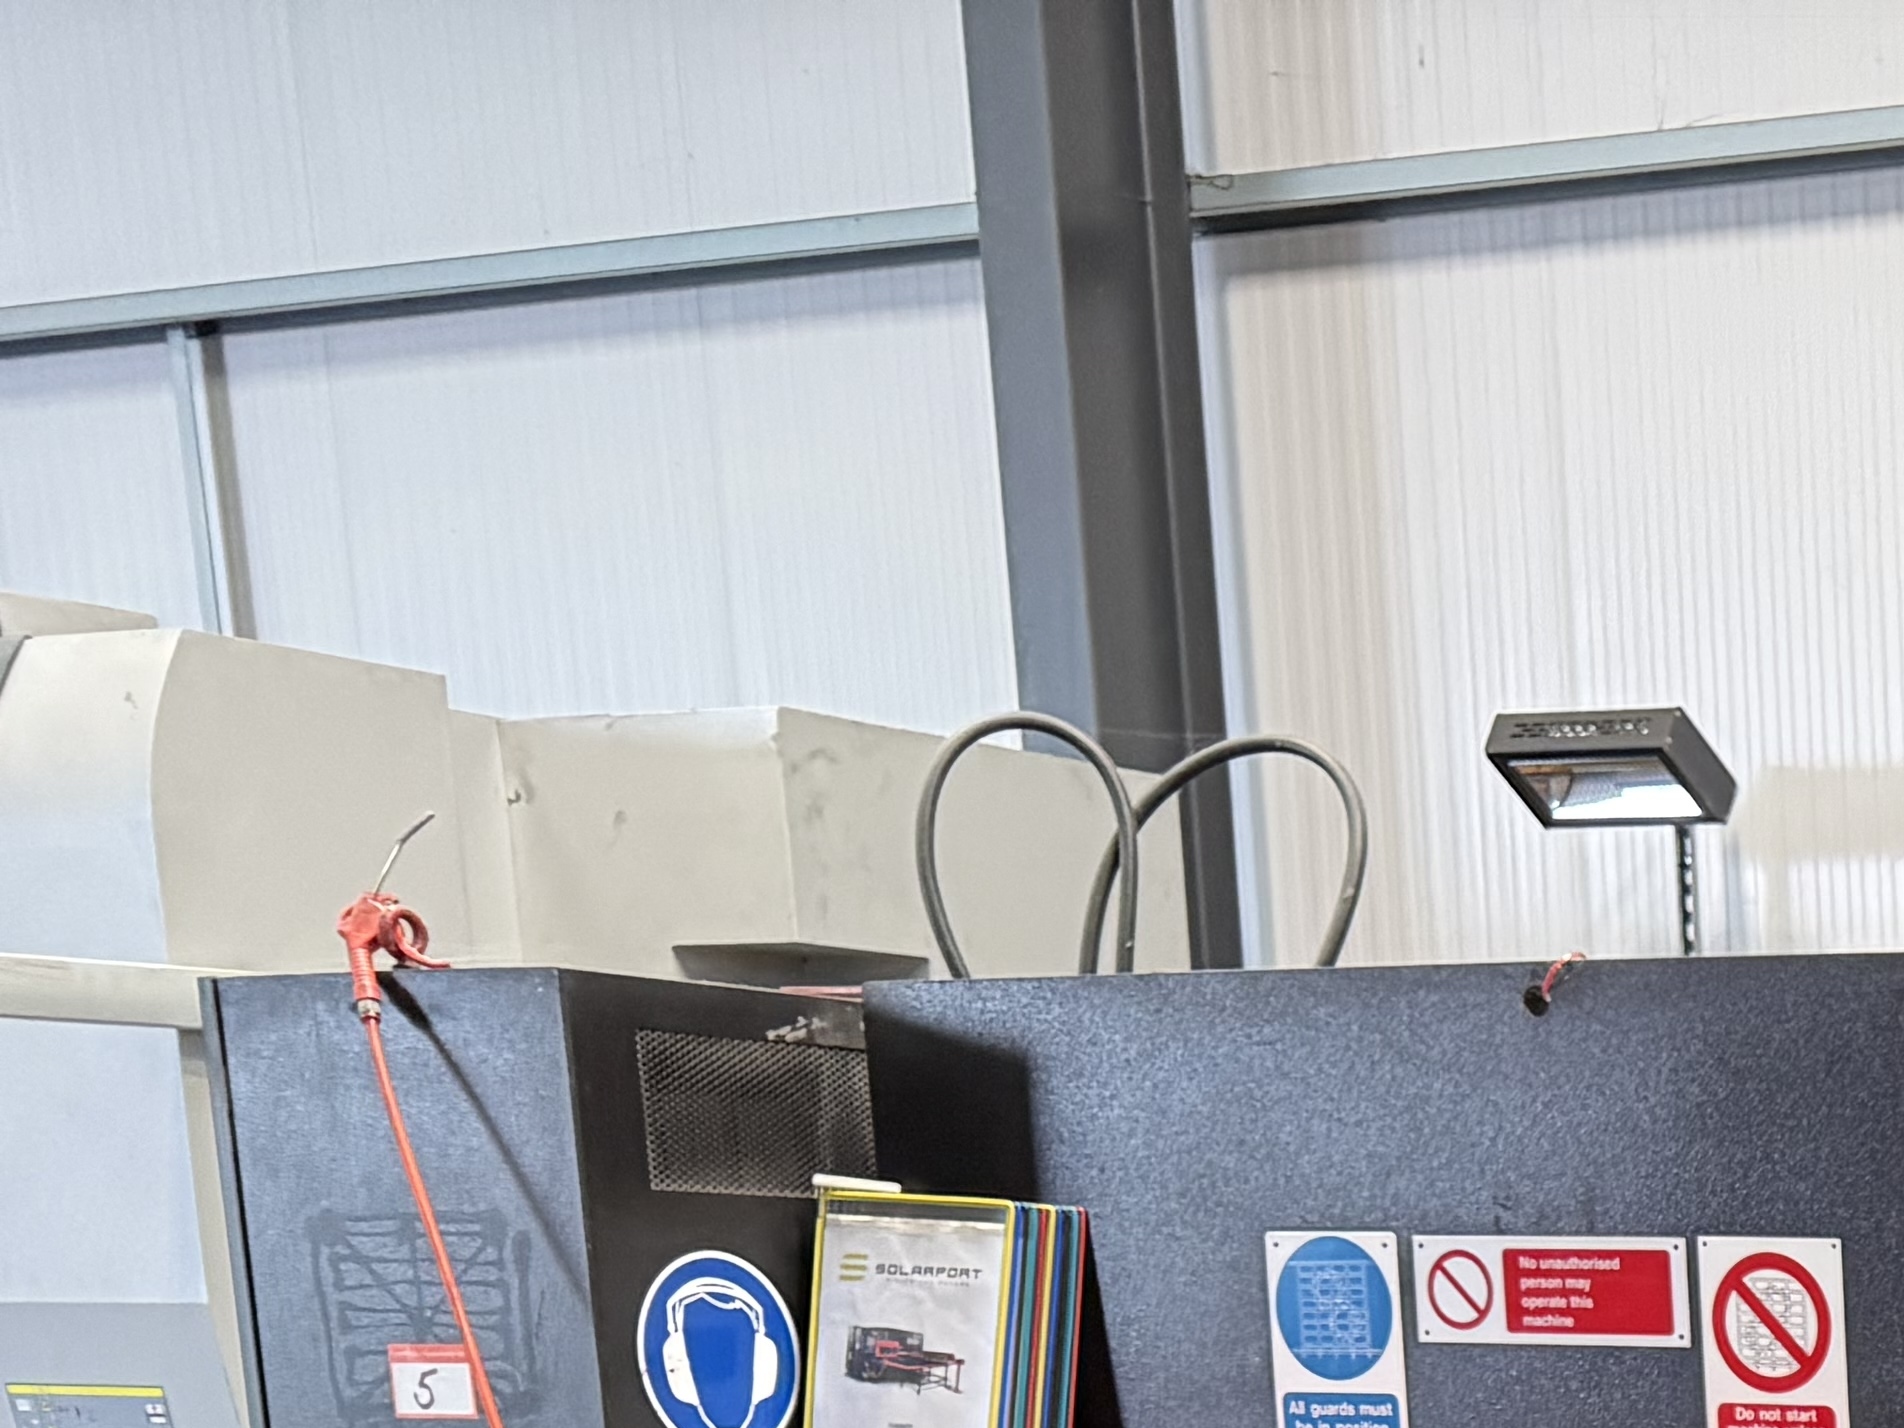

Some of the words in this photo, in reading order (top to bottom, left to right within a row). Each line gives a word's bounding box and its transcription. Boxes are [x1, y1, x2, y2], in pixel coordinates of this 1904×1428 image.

[1519, 1256, 1537, 1269] No
[1540, 1256, 1620, 1270] unauthorised
[875, 1263, 982, 1279] SOLARPORT
[1520, 1277, 1563, 1291] person
[1565, 1278, 1591, 1292] may
[1521, 1296, 1567, 1310] operate
[1570, 1295, 1594, 1309] this
[1523, 1314, 1574, 1327] machine
[1289, 1401, 1306, 1414] All
[1310, 1402, 1356, 1418] guards
[1359, 1402, 1393, 1416] must
[1735, 1406, 1755, 1421] Do
[1759, 1408, 1781, 1422] not
[1786, 1409, 1817, 1422] start
